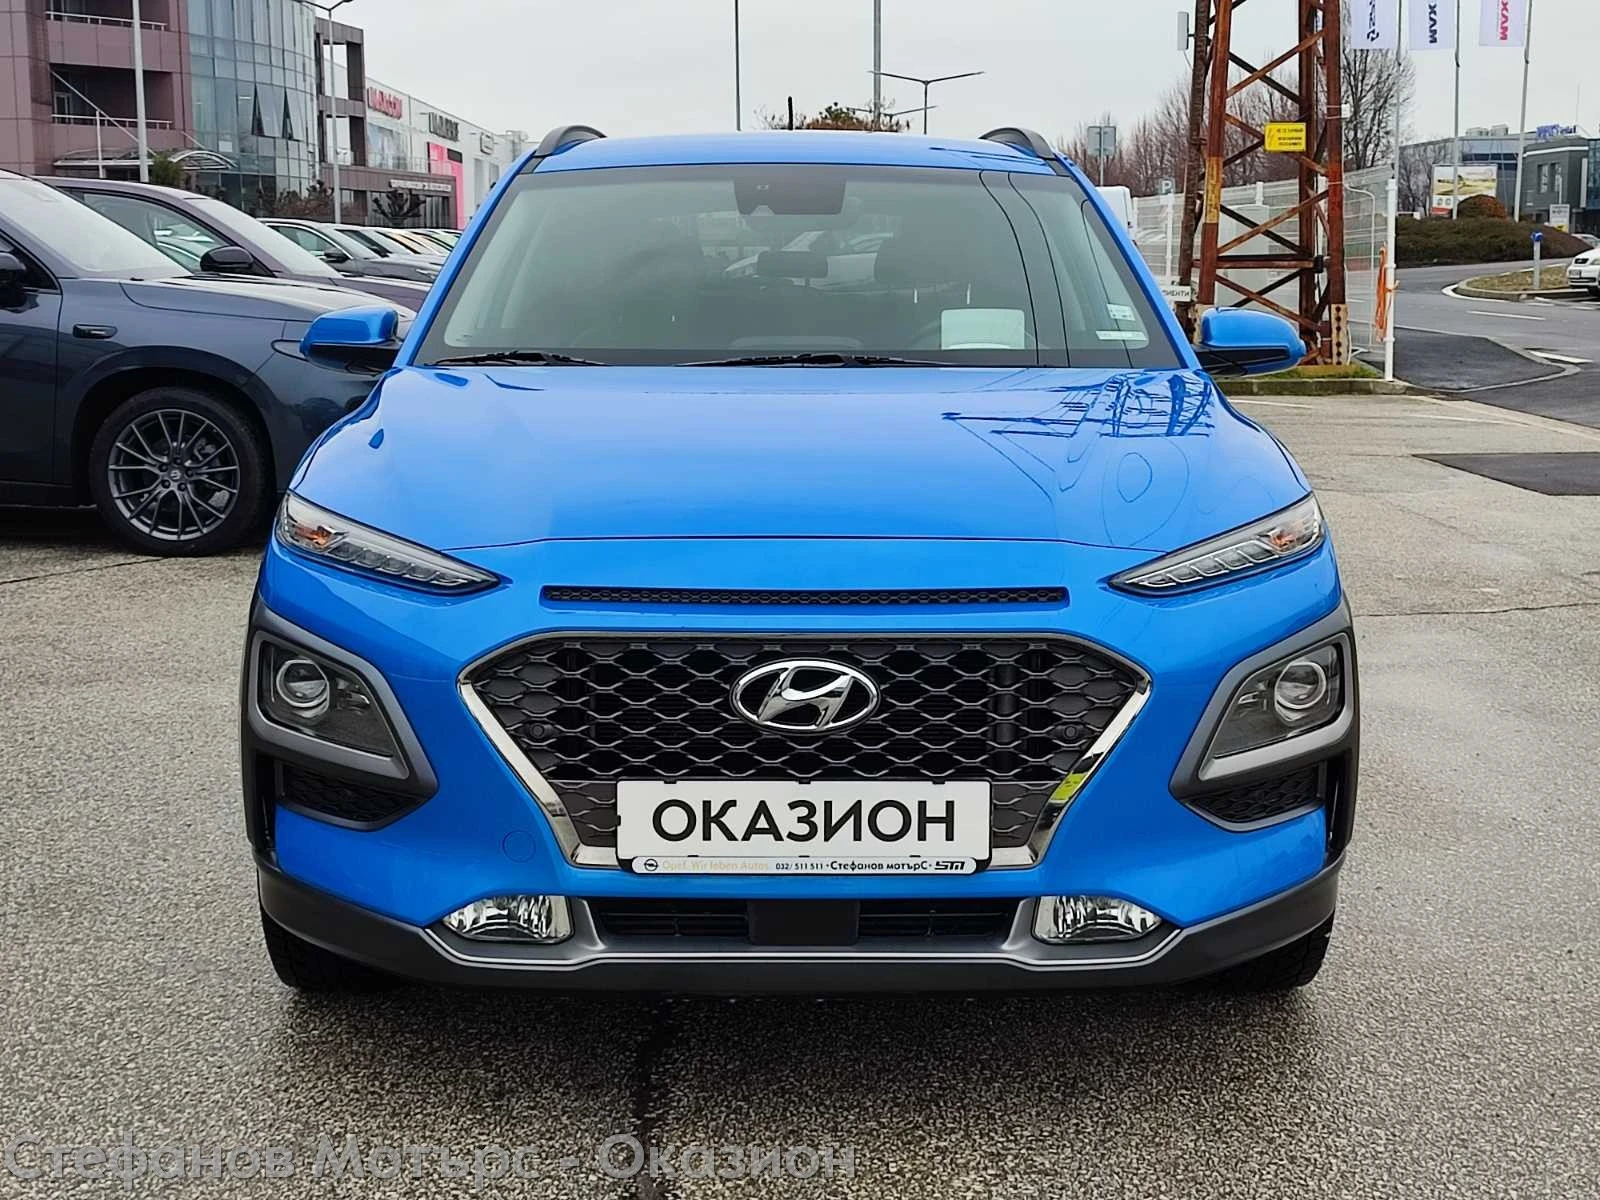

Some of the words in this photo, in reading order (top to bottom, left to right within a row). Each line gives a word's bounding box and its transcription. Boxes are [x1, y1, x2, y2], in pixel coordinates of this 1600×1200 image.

[652, 799, 955, 842] ОКАЗИОН
[795, 862, 808, 870] 511
[810, 862, 823, 870] 511
